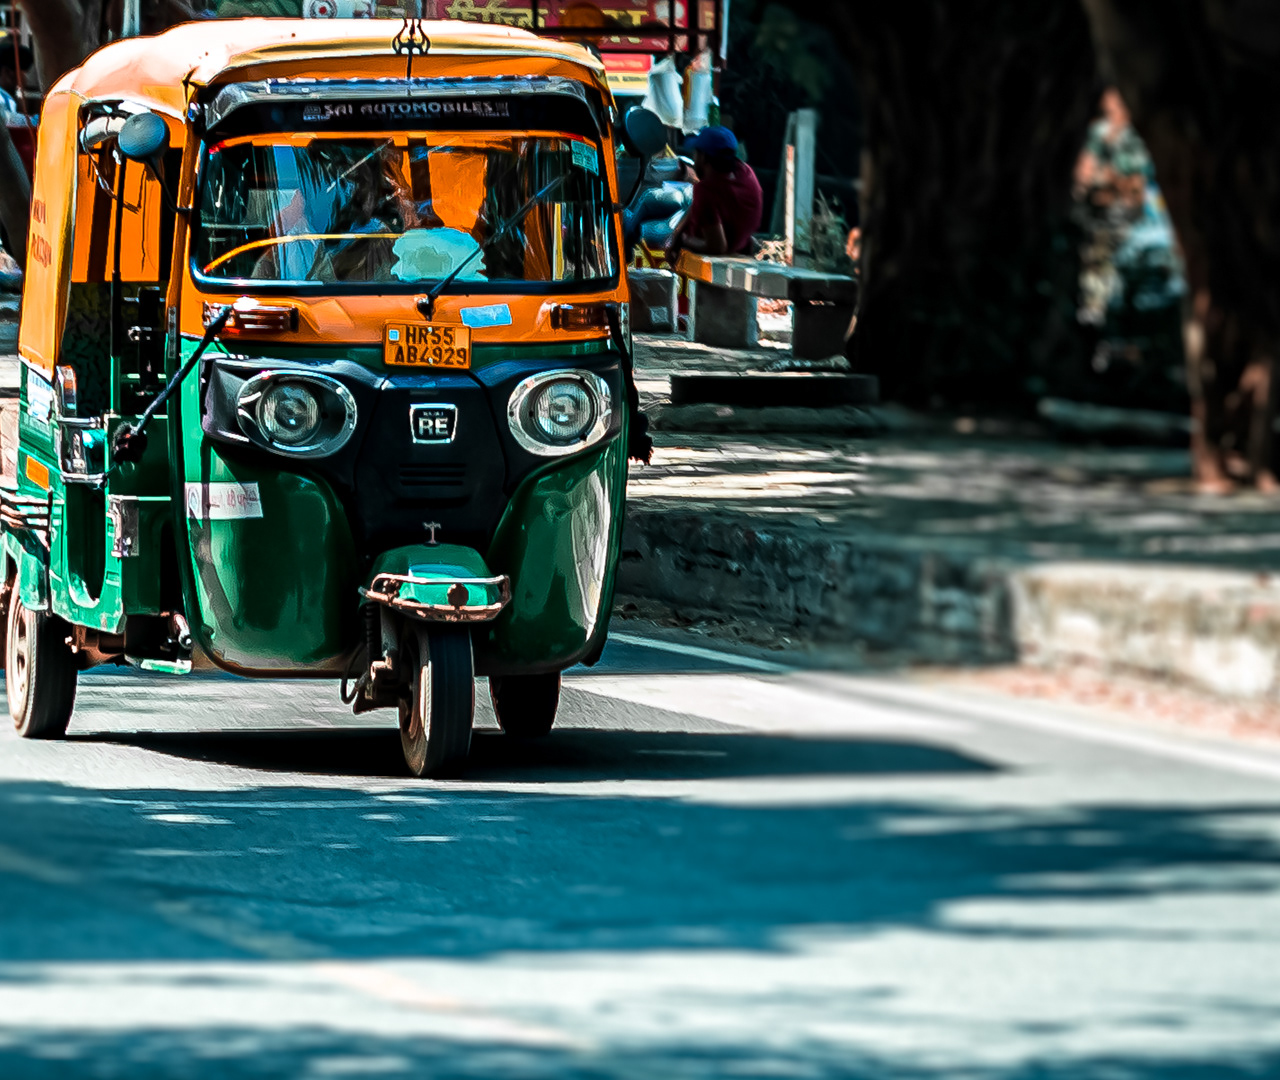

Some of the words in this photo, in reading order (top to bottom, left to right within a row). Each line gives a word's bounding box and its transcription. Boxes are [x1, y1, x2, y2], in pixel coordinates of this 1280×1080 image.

[324, 103, 353, 117] SAI
[360, 100, 492, 115] AUTOMOBILES
[405, 326, 454, 345] HR55
[394, 344, 467, 366] AB4929
[418, 417, 449, 435] RE
